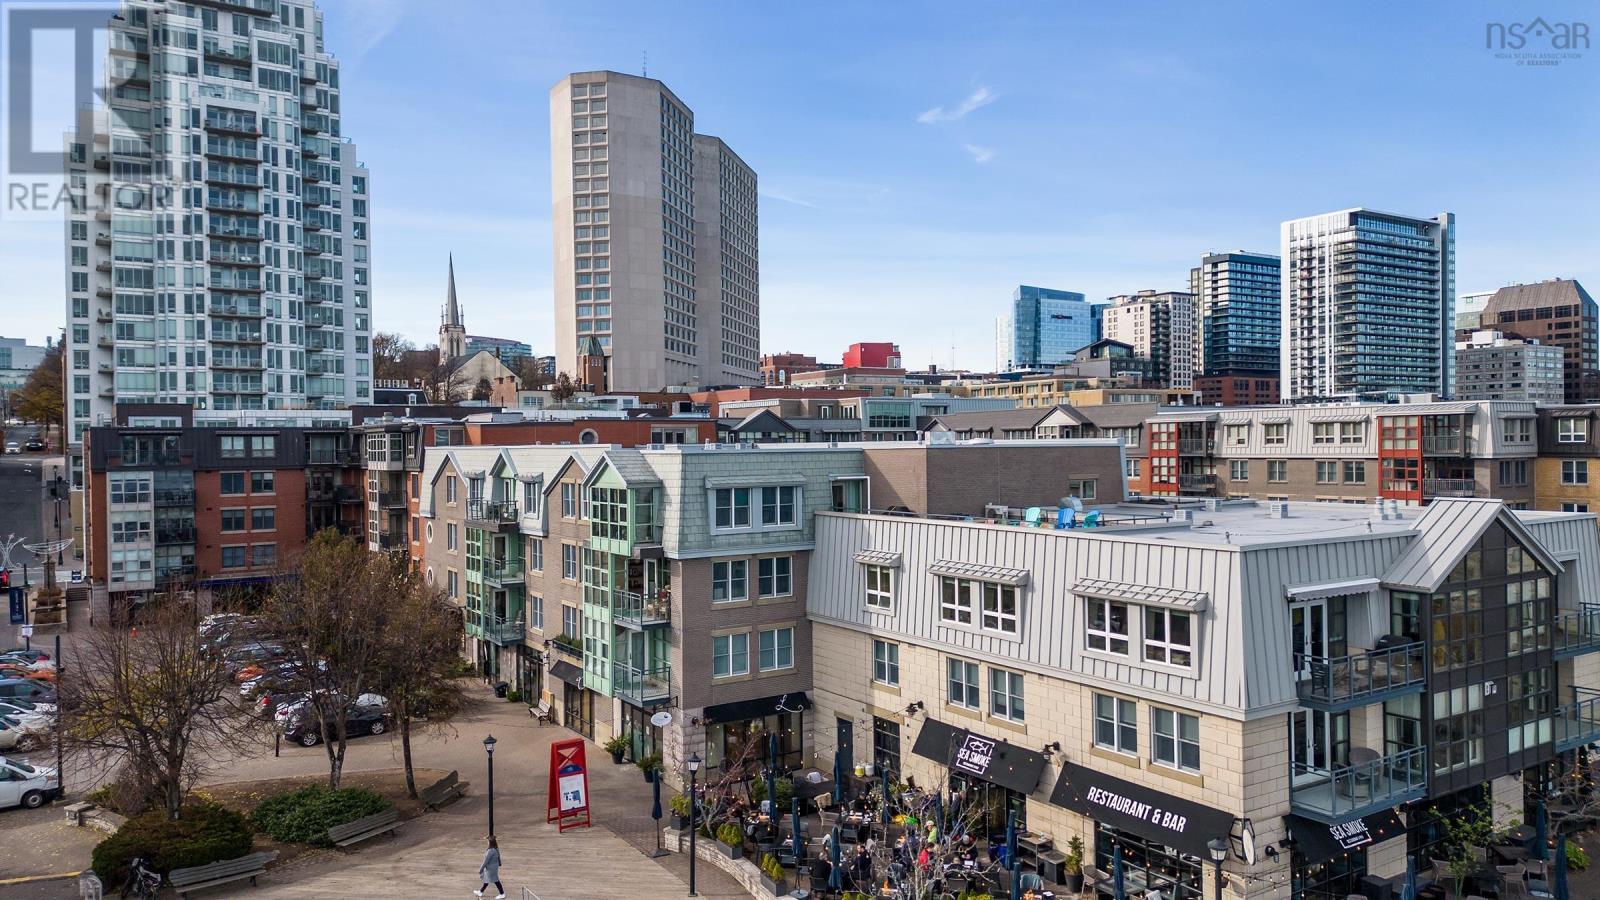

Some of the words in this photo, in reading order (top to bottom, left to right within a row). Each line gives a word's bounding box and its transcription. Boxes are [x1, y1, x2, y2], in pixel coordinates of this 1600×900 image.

[957, 748, 971, 761] SEA
[969, 751, 992, 768] SMOKE
[1086, 786, 1152, 820] RESTAURANT
[1152, 808, 1162, 825] &
[1162, 811, 1187, 833] BAR
[1329, 825, 1348, 840] SEA
[1342, 819, 1369, 836] SMOKE
